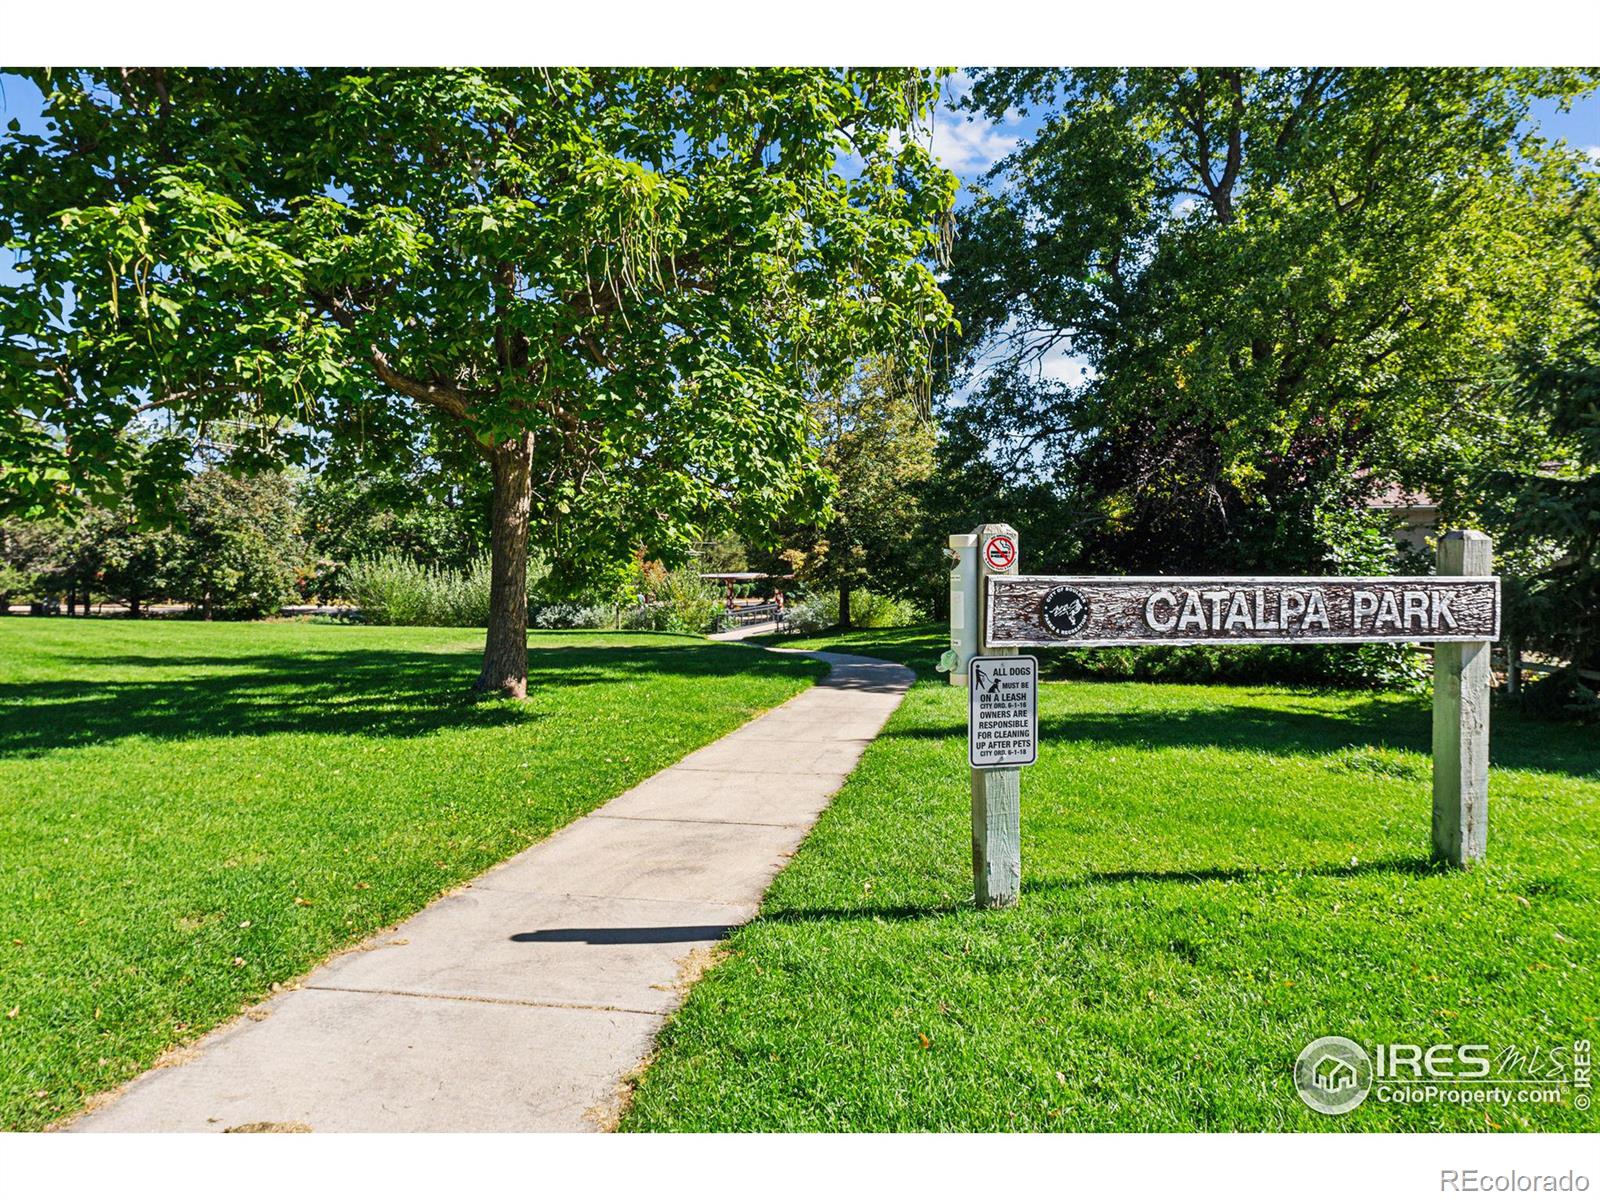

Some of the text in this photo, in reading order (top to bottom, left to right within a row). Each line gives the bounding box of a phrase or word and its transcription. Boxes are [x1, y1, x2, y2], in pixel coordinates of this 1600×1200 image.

[1145, 588, 1458, 632] CATALPA PARK
[993, 667, 1031, 676] ALL DOGS
[1021, 681, 1029, 689] BE
[980, 692, 1027, 702] ON A LEASH
[980, 710, 1028, 719] OWNERS ARE
[979, 720, 1028, 729] RESPONSIBLE
[978, 730, 1030, 740] FOR CLEANING
[976, 740, 1031, 750] UP AFTER PETS
